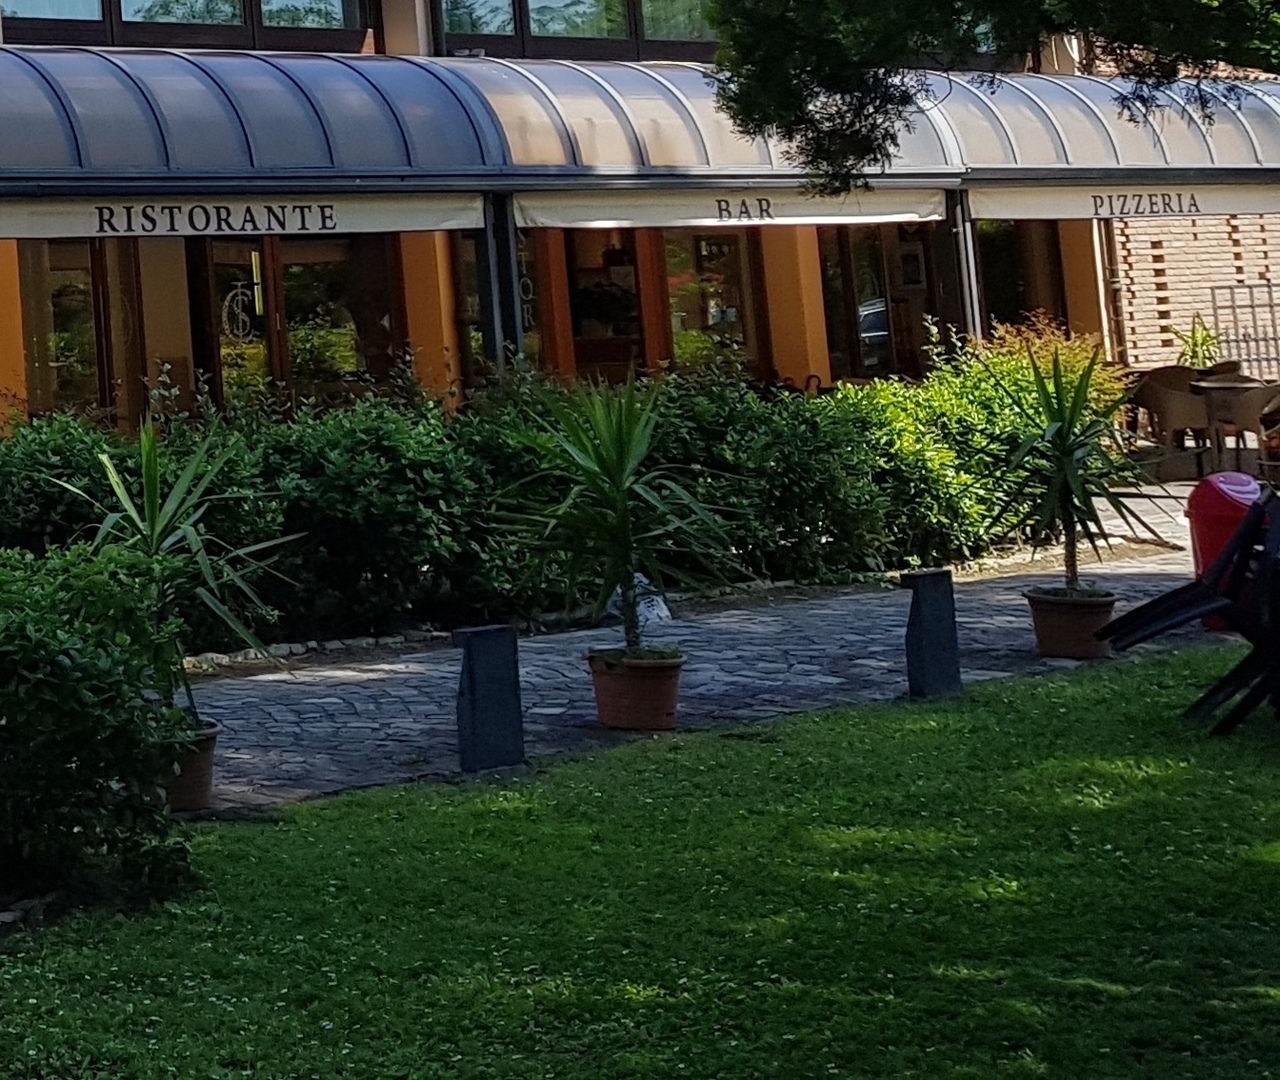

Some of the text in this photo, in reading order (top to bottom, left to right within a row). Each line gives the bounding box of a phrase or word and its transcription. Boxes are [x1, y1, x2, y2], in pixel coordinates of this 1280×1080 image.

[715, 198, 775, 222] BAR
[1091, 192, 1202, 217] PIZZERIA
[94, 204, 338, 234] RISTORANTE
